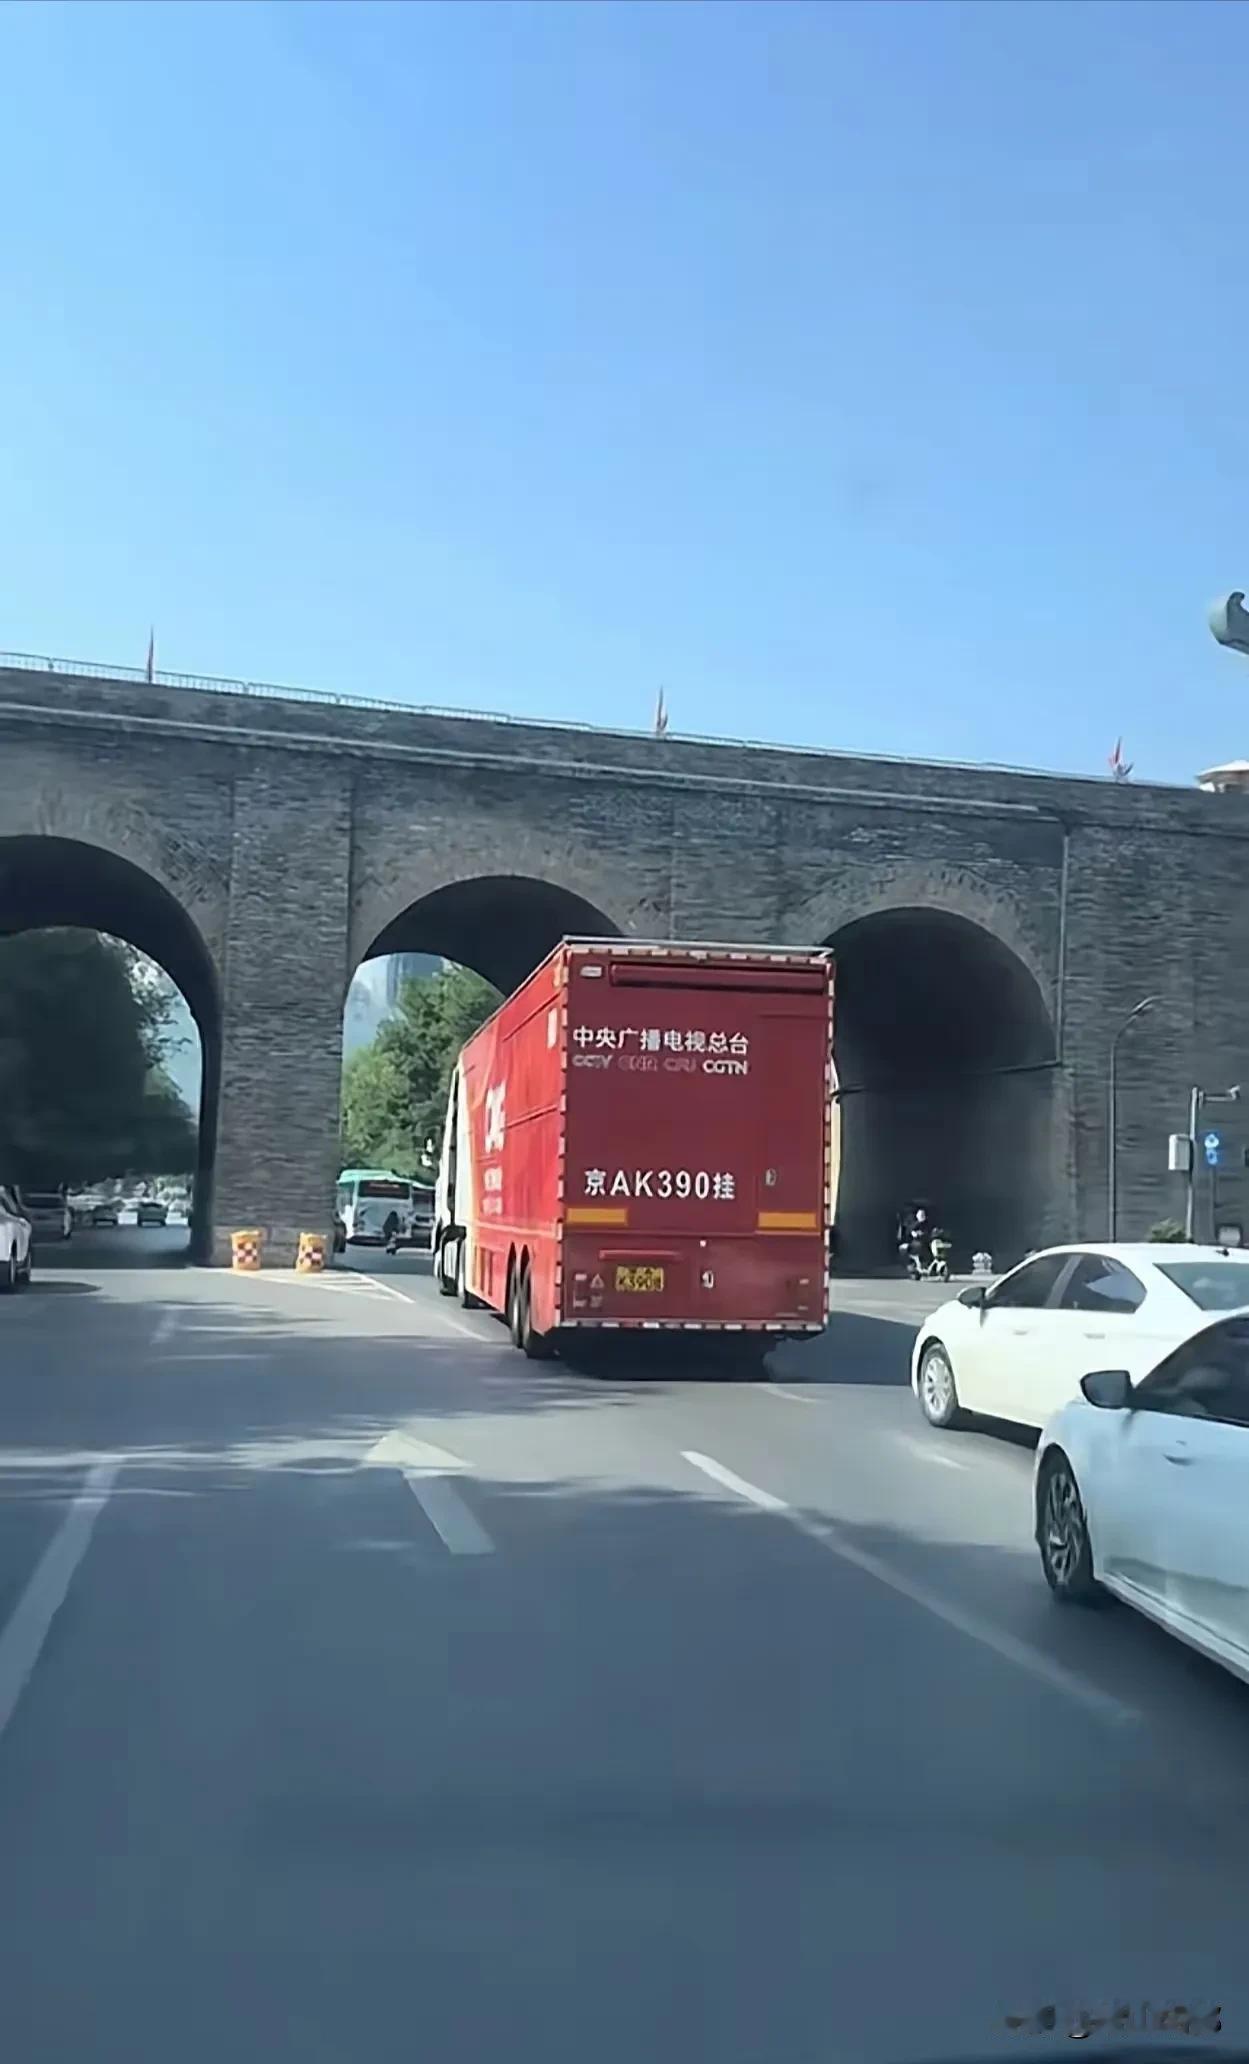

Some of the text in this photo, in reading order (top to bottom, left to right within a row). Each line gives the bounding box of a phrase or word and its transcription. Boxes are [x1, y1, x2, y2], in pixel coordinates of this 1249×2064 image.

[573, 1025, 748, 1055] 中央广播电视总台
[702, 1060, 748, 1076] CGTN
[584, 1168, 736, 1200] 京AK390挂
